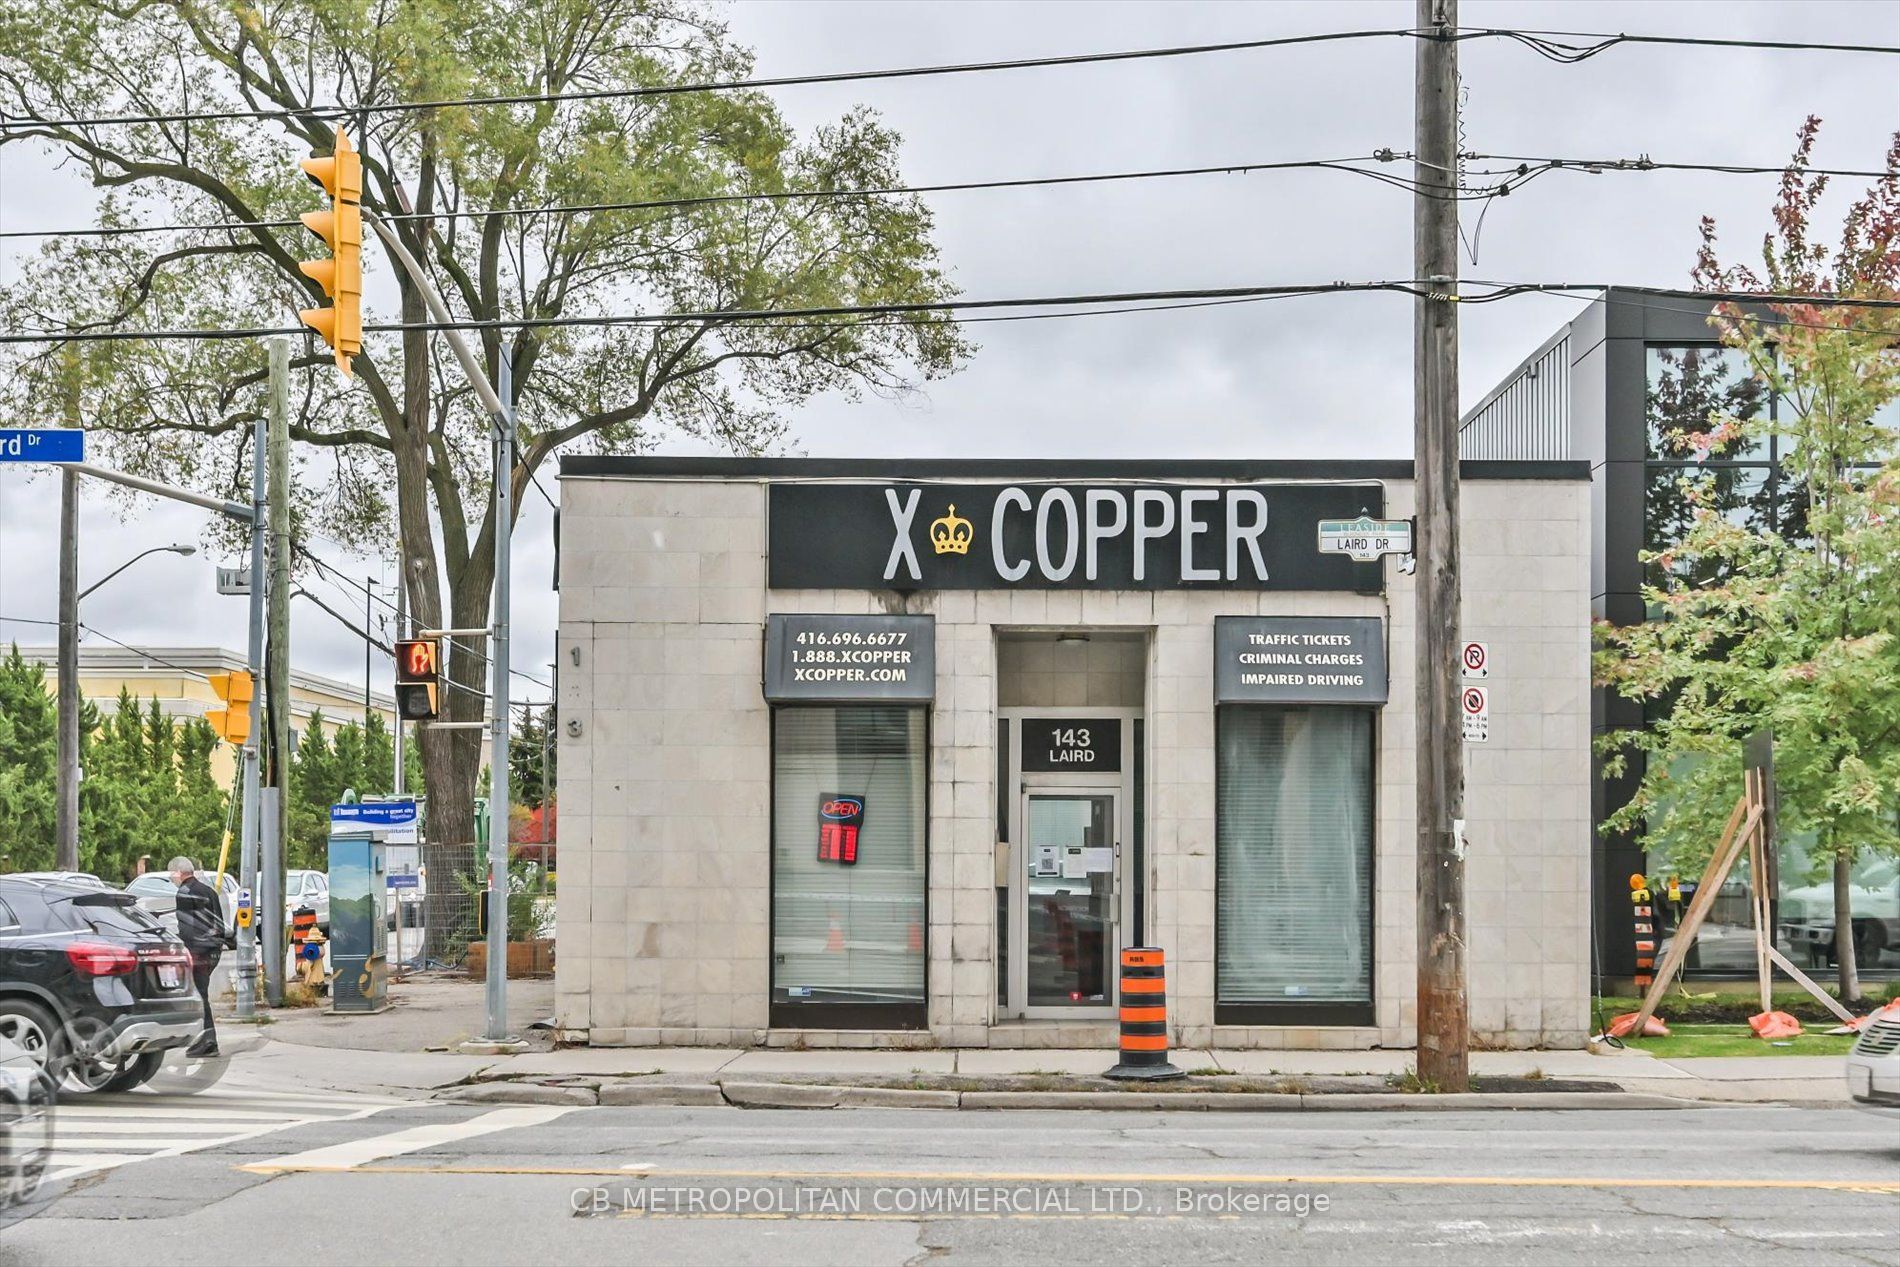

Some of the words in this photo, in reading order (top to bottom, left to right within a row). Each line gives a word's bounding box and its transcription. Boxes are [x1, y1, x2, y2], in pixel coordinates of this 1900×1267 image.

[28, 434, 41, 446] Dr
[883, 488, 922, 580] X
[991, 487, 1269, 582] COPPER
[1337, 538, 1367, 550] LAIRD
[796, 632, 907, 645] 416.696.6677
[1249, 634, 1299, 645] TRAFFIC
[1302, 634, 1351, 646] TICKETS
[792, 650, 911, 663] 1.888.XCOPPER
[1239, 653, 1302, 665] CRIMINAL
[1304, 654, 1363, 665] CHARGES
[794, 668, 906, 681] XCOPPER.COM
[1241, 673, 1303, 685] IMPAIRED
[1308, 675, 1363, 686] DRIVING
[1052, 728, 1091, 747] 143
[1049, 749, 1095, 762] LAIRD
[823, 801, 859, 816] OPEN
